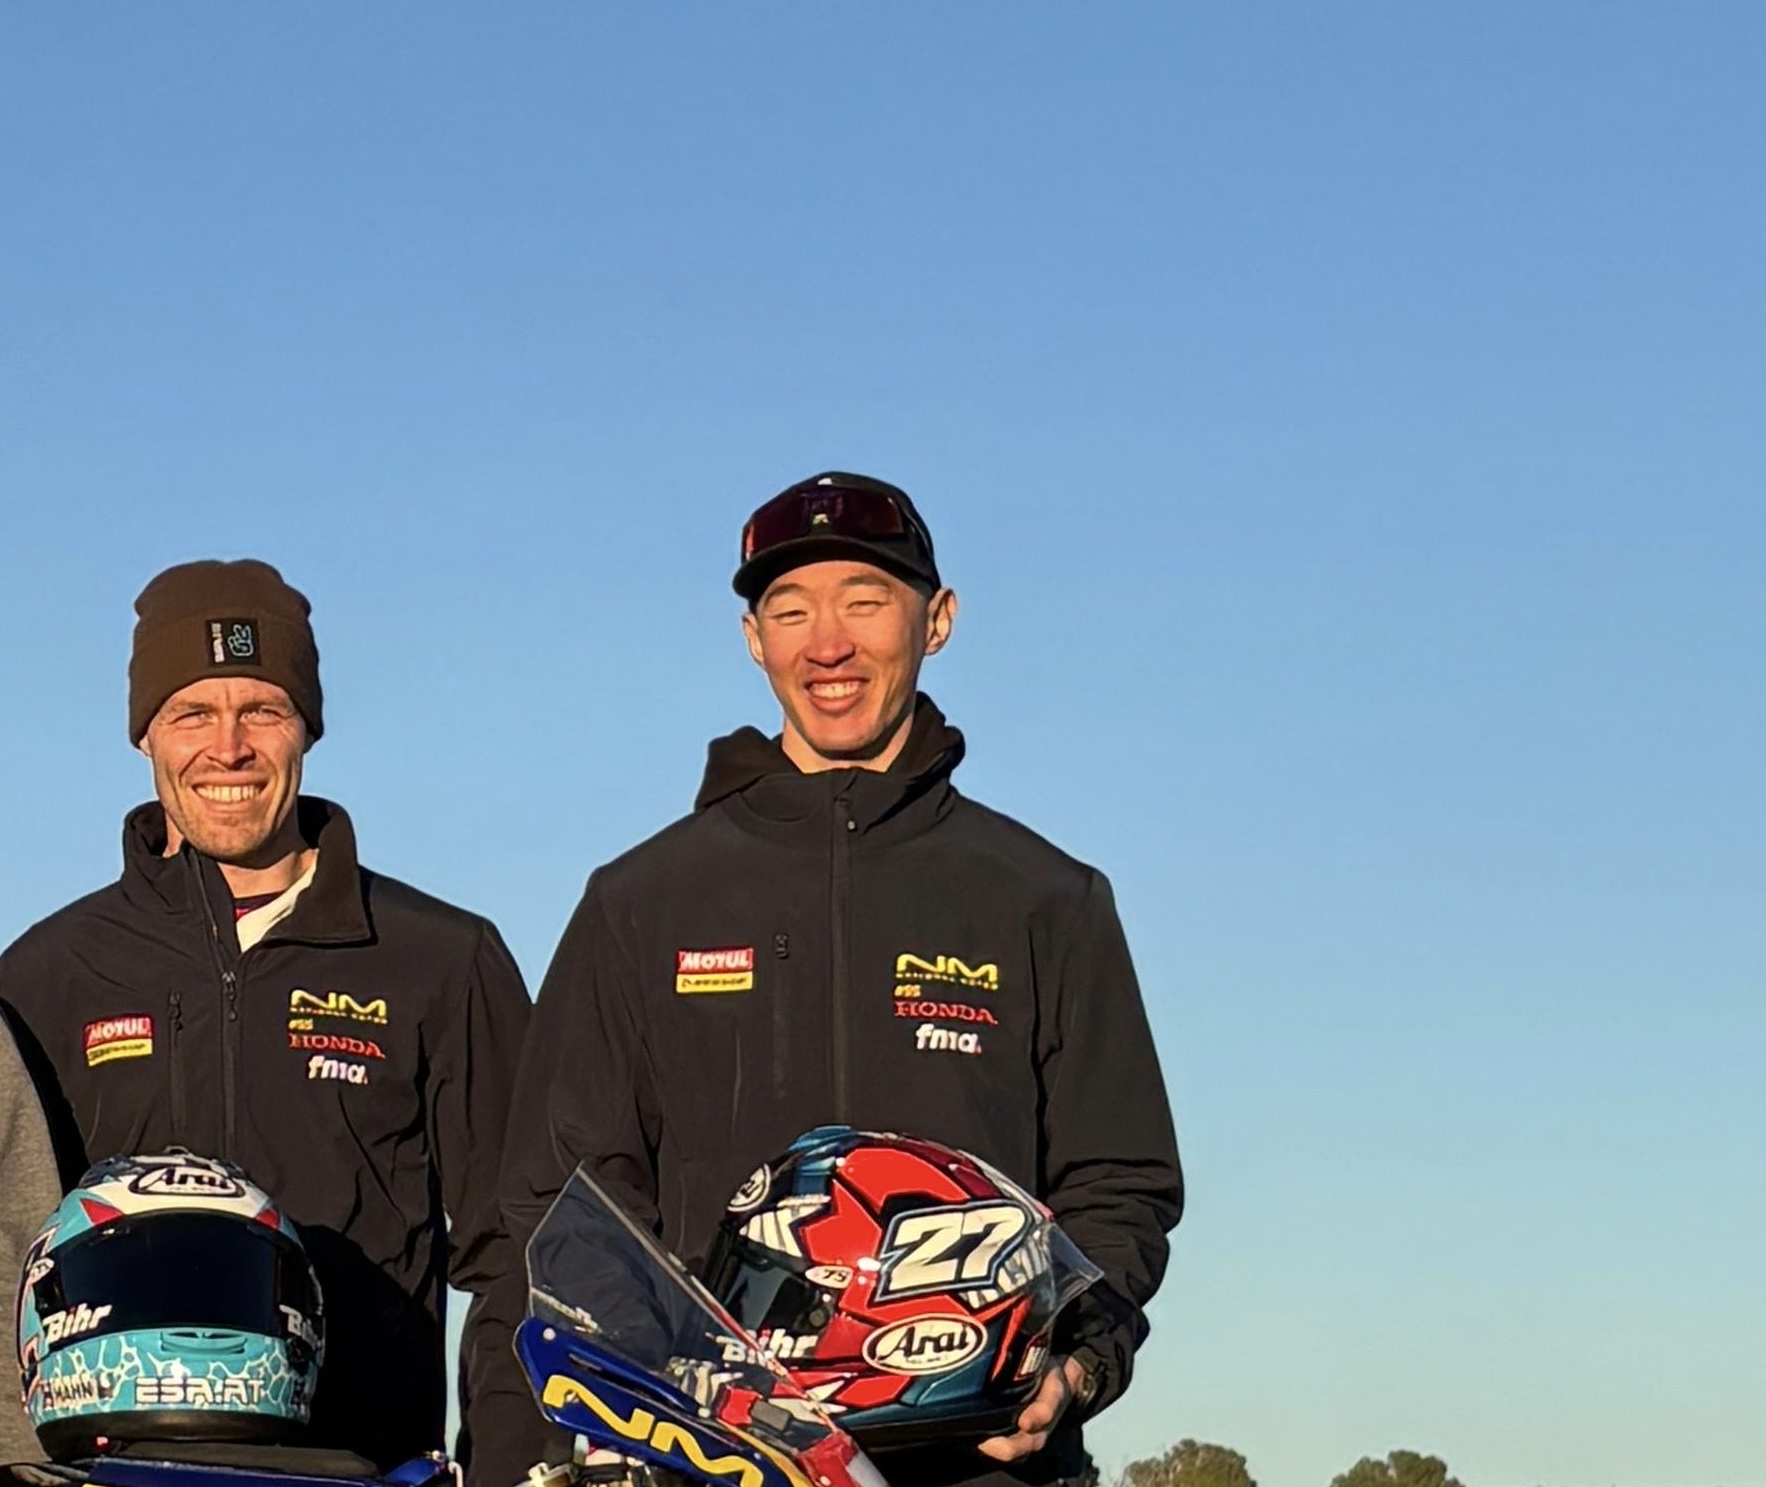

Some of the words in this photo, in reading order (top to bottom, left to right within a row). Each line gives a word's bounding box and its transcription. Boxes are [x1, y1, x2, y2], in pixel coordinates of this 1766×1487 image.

[681, 950, 748, 972] MOTUL
[896, 953, 998, 983] NM
[291, 989, 387, 1017] NM
[894, 1001, 999, 1025] HONDA
[288, 1033, 387, 1060] HONDA
[140, 1167, 233, 1191] Arai
[888, 1205, 1026, 1291] 27
[42, 1302, 113, 1343] Bihr
[876, 1325, 970, 1361] Arai
